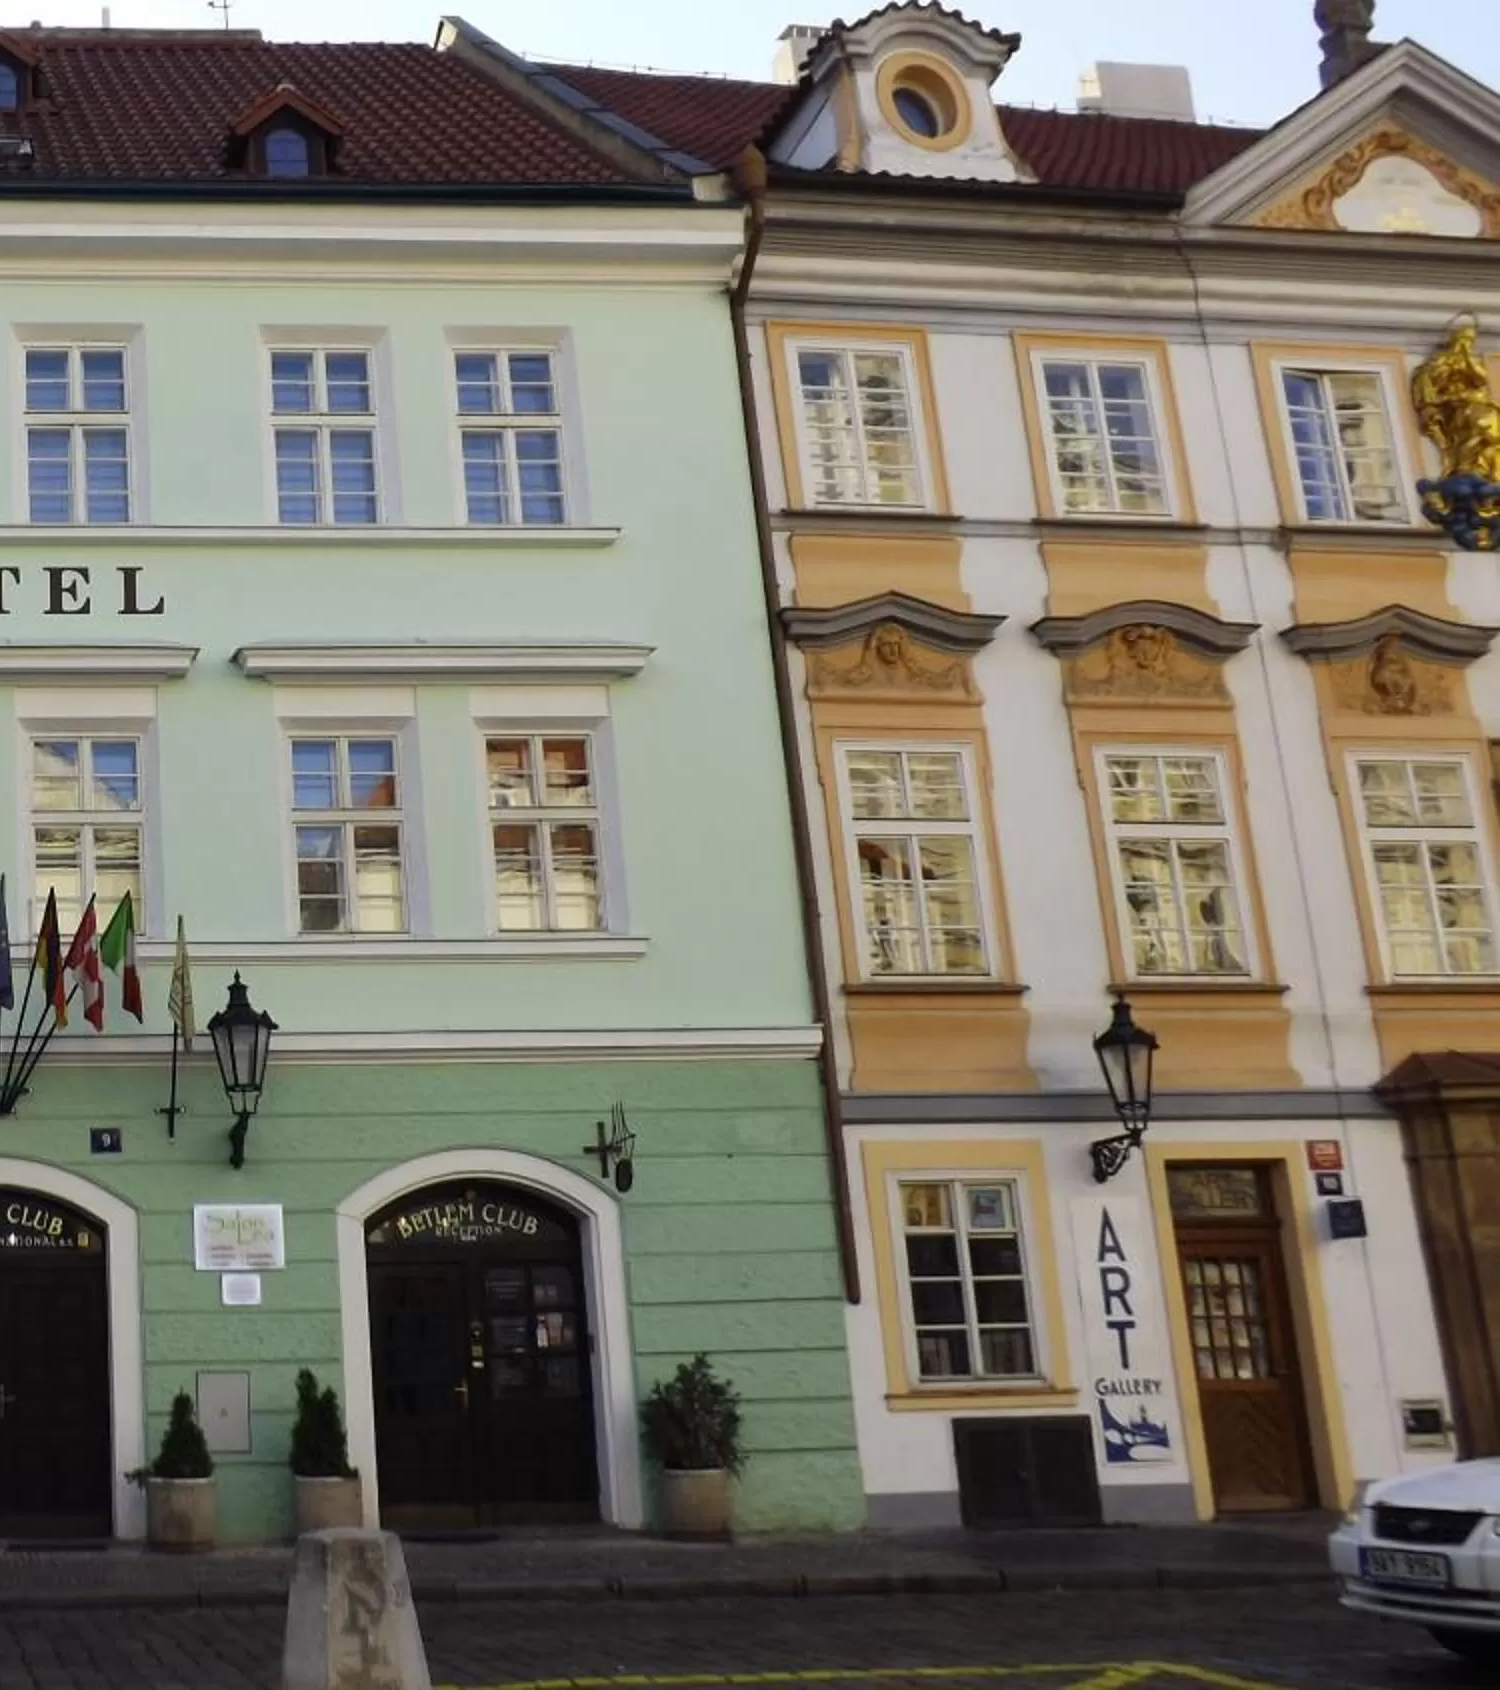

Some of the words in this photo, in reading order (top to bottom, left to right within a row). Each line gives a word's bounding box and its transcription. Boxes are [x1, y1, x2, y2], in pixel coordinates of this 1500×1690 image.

[101, 1132, 111, 1148] 9
[6, 1203, 64, 1235] CLUB
[397, 1203, 475, 1239] BETLEM
[481, 1203, 539, 1235] CLUB
[1097, 1206, 1136, 1370] ART
[1095, 1377, 1162, 1398] GALLERY
